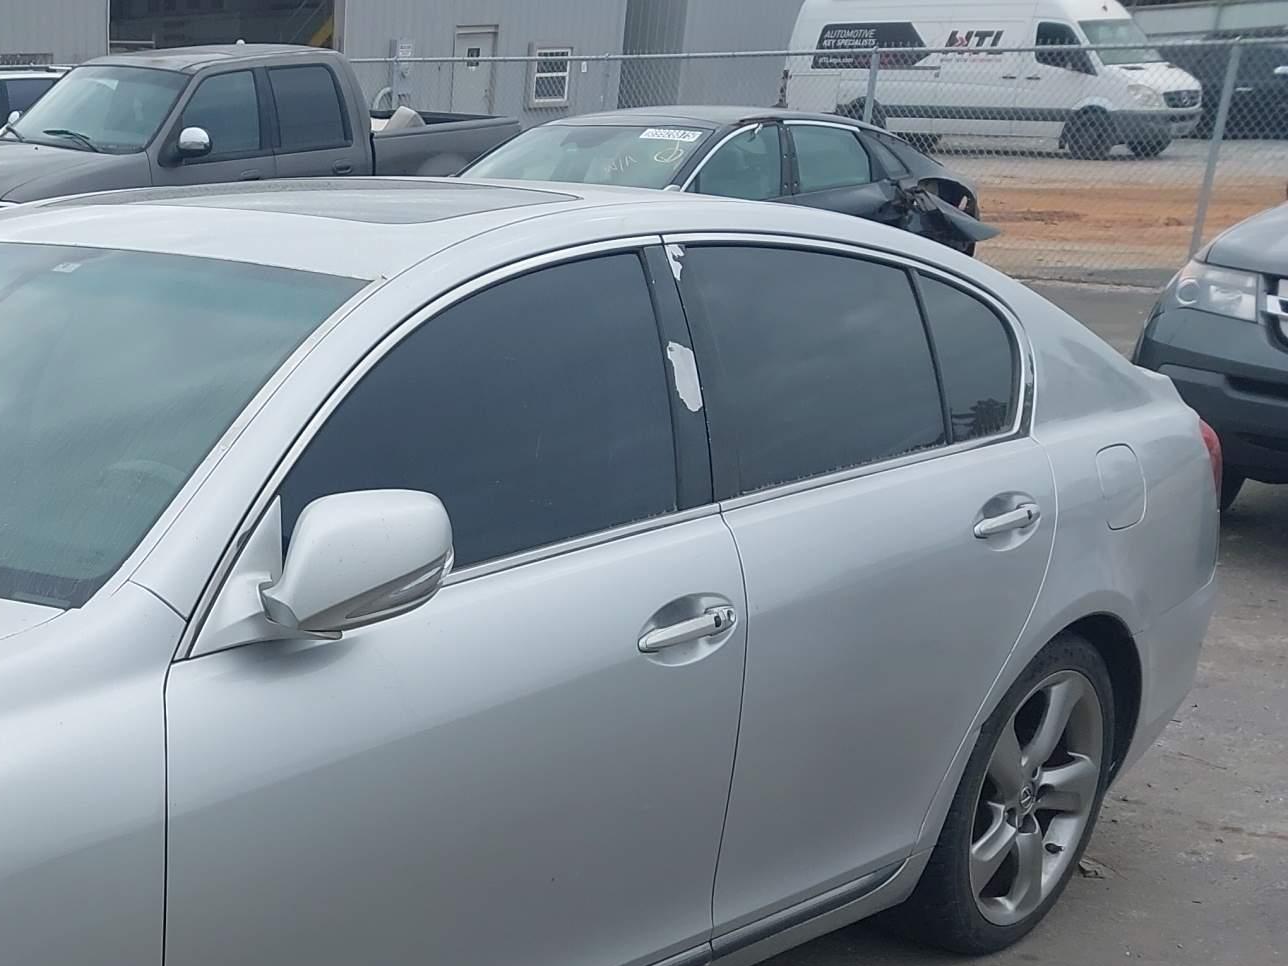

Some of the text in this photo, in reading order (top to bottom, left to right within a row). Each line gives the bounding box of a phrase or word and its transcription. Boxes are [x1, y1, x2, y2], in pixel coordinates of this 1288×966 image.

[823, 28, 877, 38] AUTOMOTIVE
[822, 38, 877, 47] KEY SPECIALISTS
